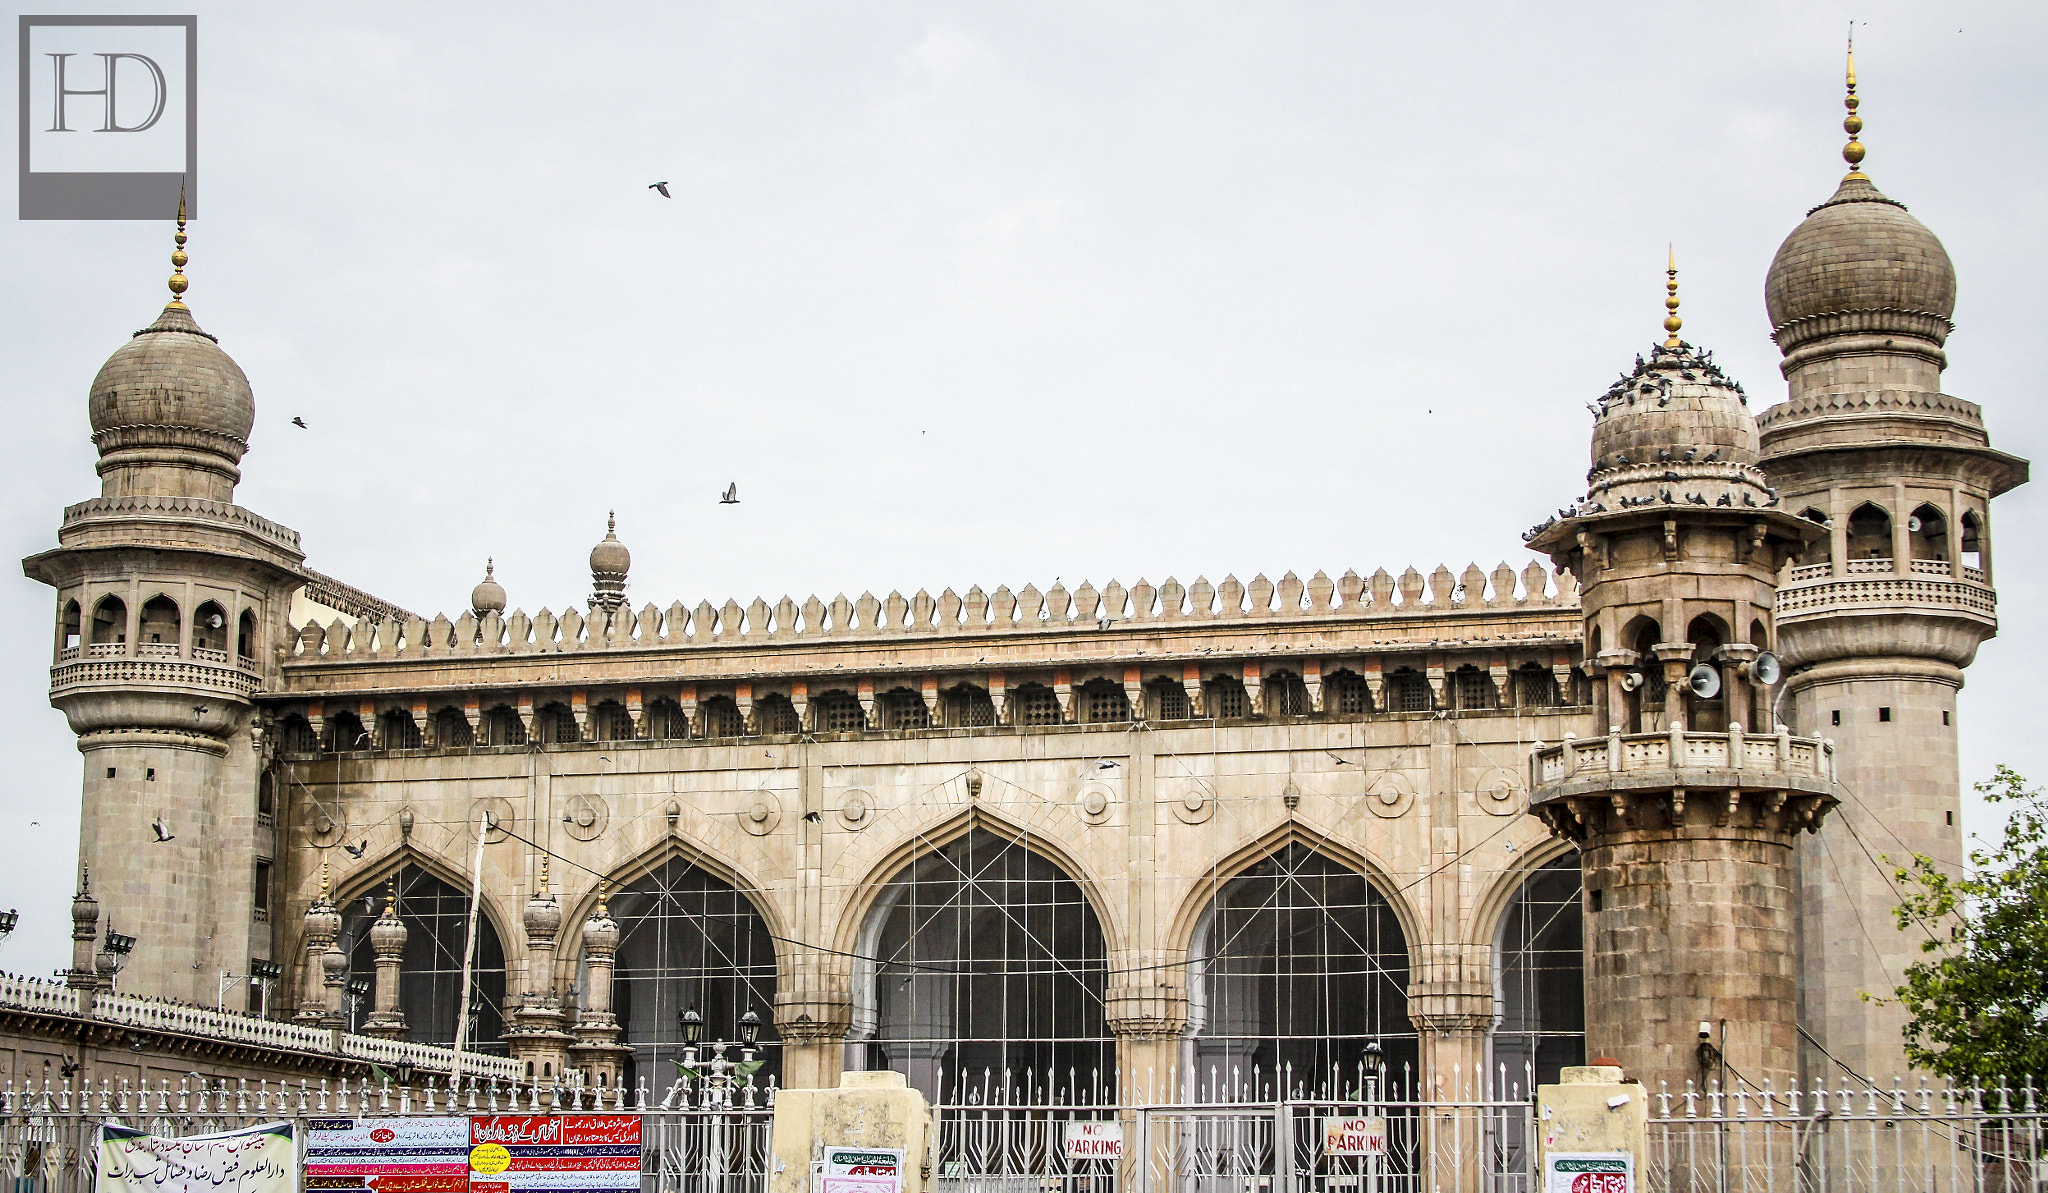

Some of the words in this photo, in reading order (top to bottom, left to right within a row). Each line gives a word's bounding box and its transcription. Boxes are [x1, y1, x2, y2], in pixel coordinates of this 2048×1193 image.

[518, 1118, 532, 1141] کے
[583, 1121, 591, 1129] اور
[591, 1118, 605, 1129] طلاق
[628, 1116, 641, 1131] مسلم
[1083, 1124, 1103, 1136] NO
[1343, 1120, 1366, 1131] NO
[608, 1129, 622, 1143] کیس
[1327, 1133, 1384, 1152] PARKING
[1067, 1139, 1121, 1155] PARKING
[195, 1165, 212, 1181] رضا
